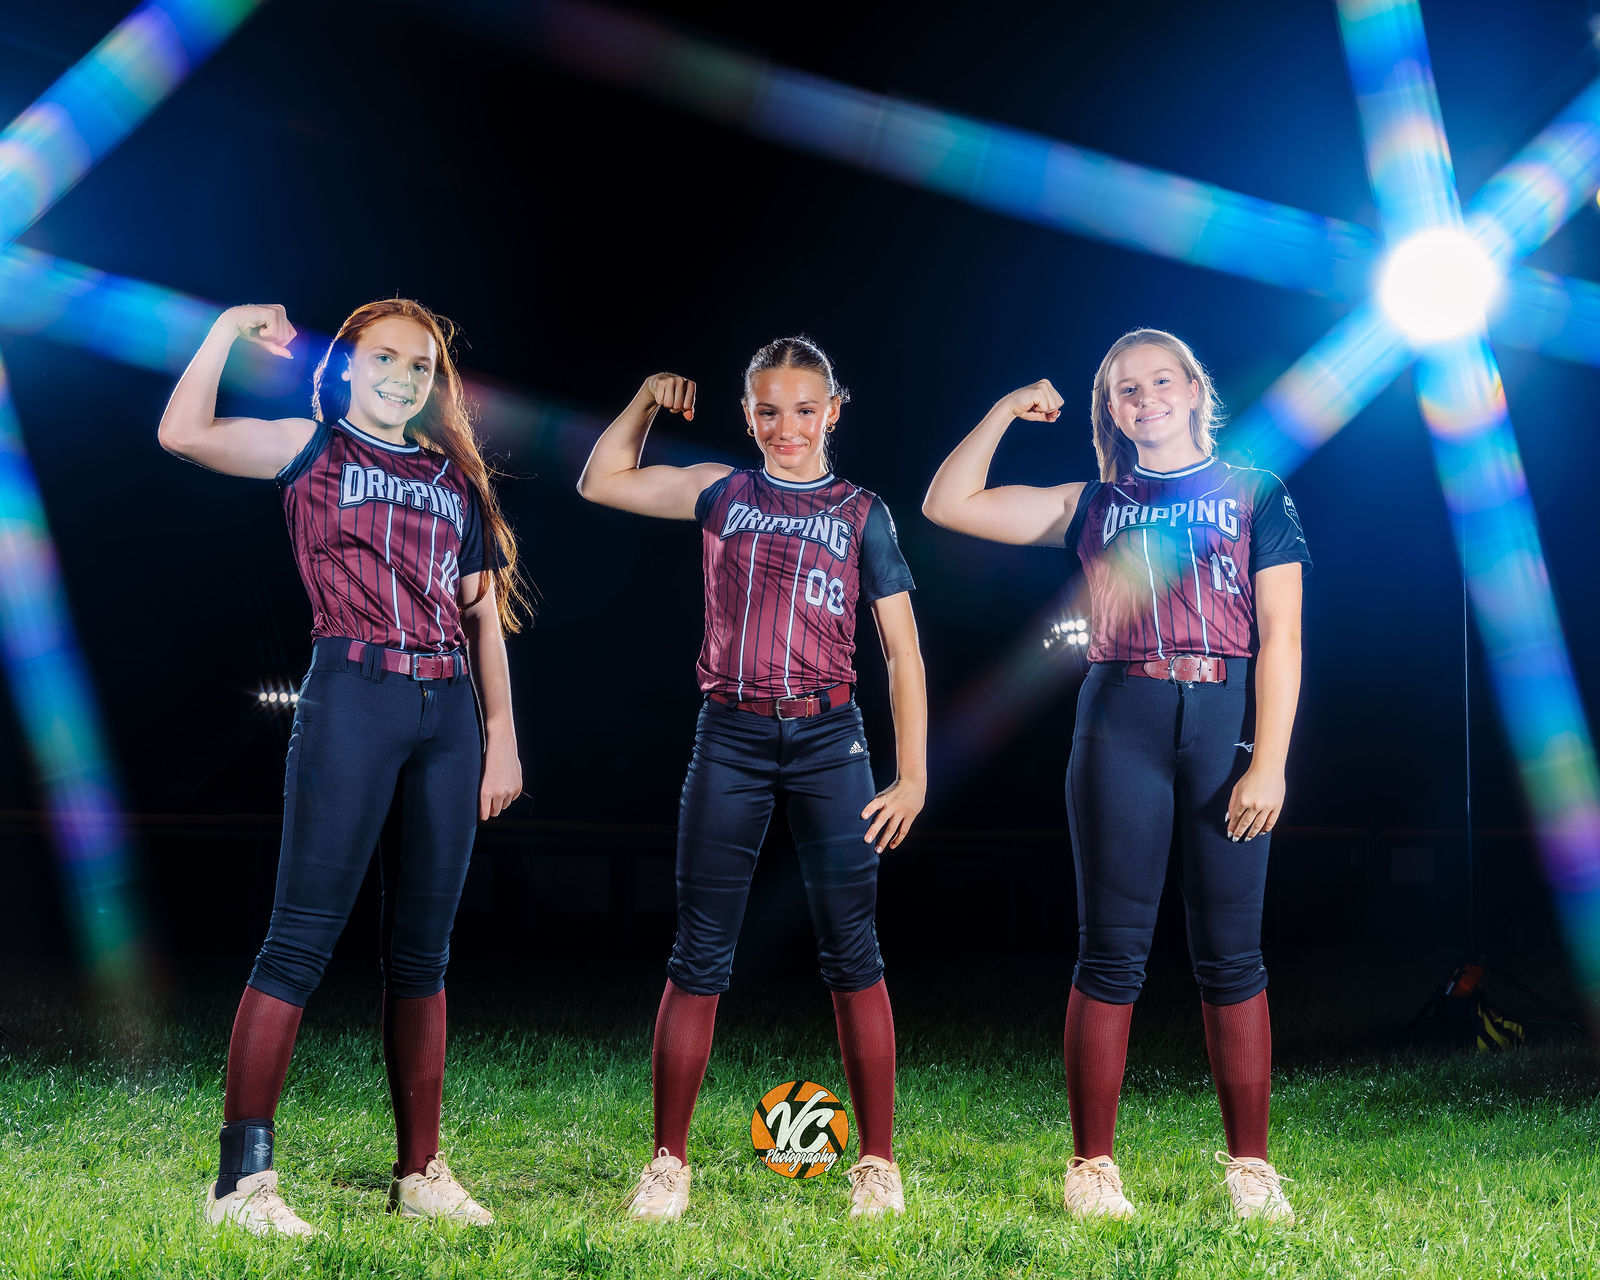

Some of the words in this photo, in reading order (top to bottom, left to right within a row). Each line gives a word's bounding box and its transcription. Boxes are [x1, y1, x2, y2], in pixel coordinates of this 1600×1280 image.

[720, 500, 851, 561] DRIPPING
[1102, 498, 1240, 548] DRIPPING
[804, 568, 845, 616] 00
